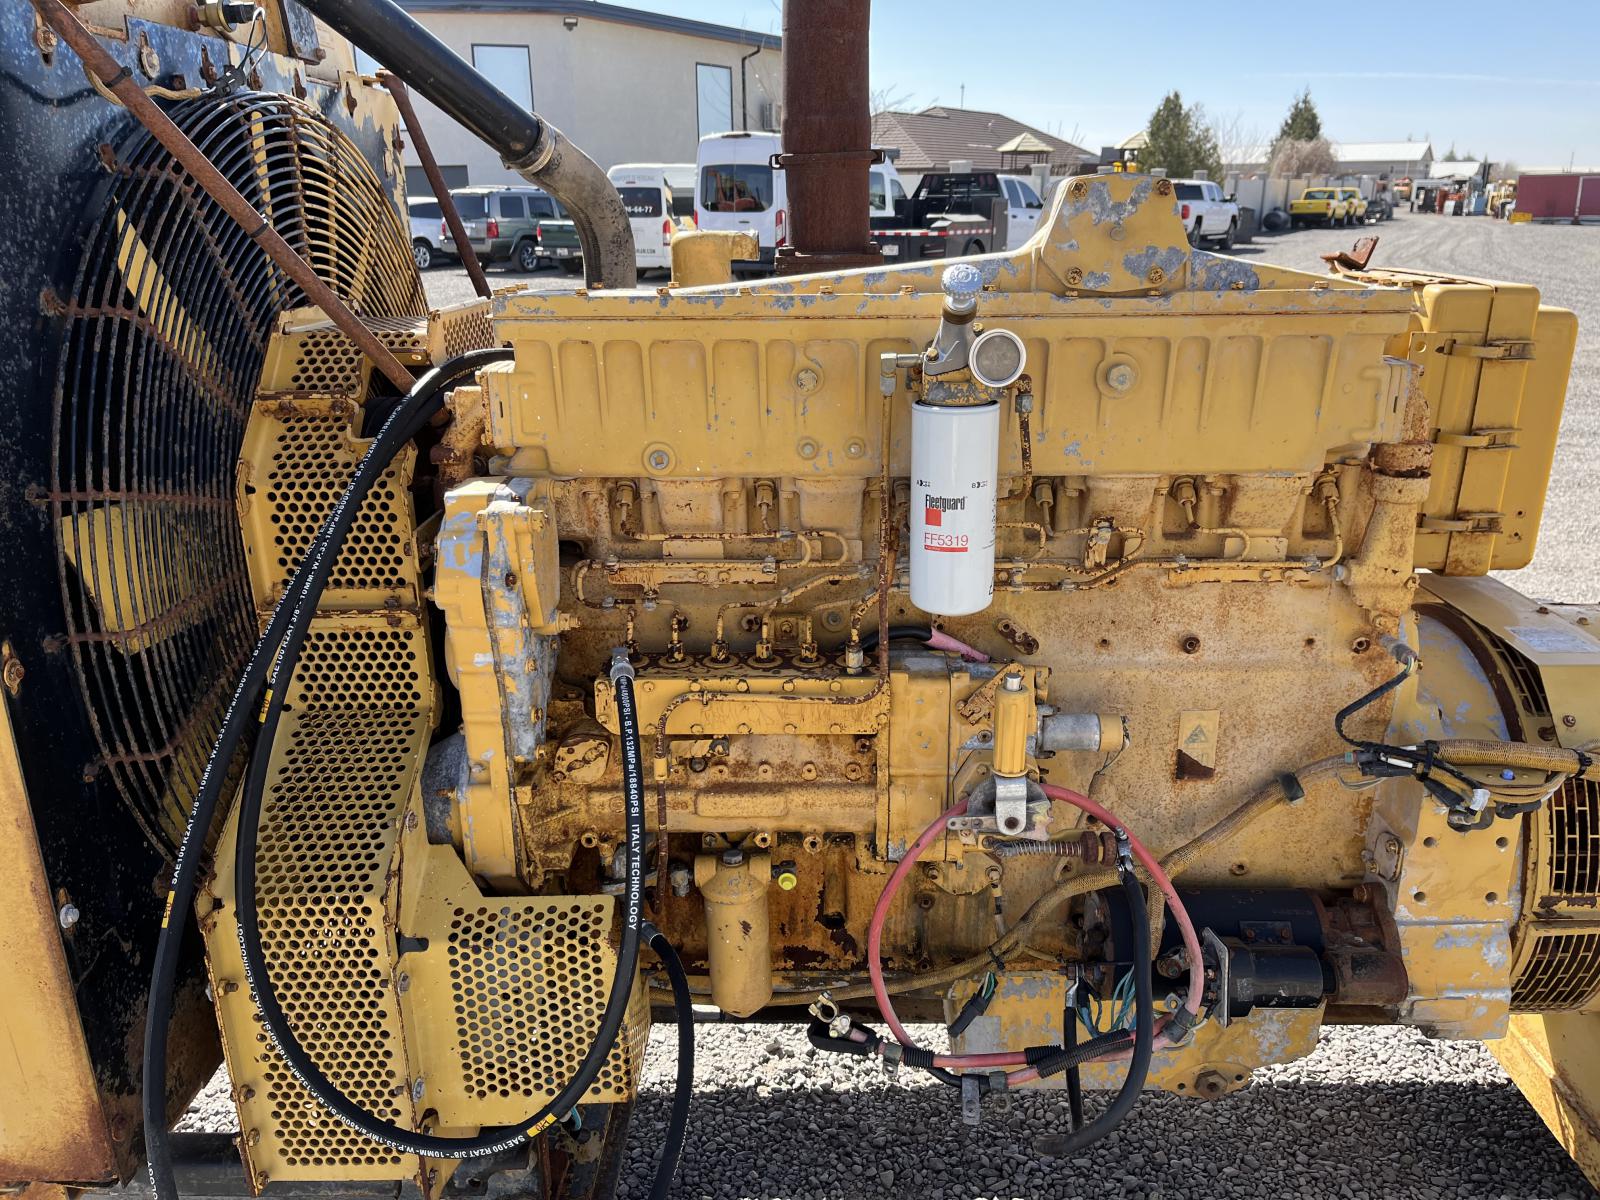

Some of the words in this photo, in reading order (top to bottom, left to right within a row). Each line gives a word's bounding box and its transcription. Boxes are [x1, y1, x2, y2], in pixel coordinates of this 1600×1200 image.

[925, 494, 965, 512] Fleetguard
[924, 532, 968, 546] FF5319
[270, 649, 286, 684] SAE100
[623, 720, 639, 817] B.P.132MPa/18840PSI
[631, 824, 640, 852] ITALY
[627, 855, 639, 930] TECHNOLOGY
[236, 921, 255, 987] TECHNOLOGY
[468, 1146, 492, 1157] R2AT
[491, 1133, 525, 1153] SAE100
